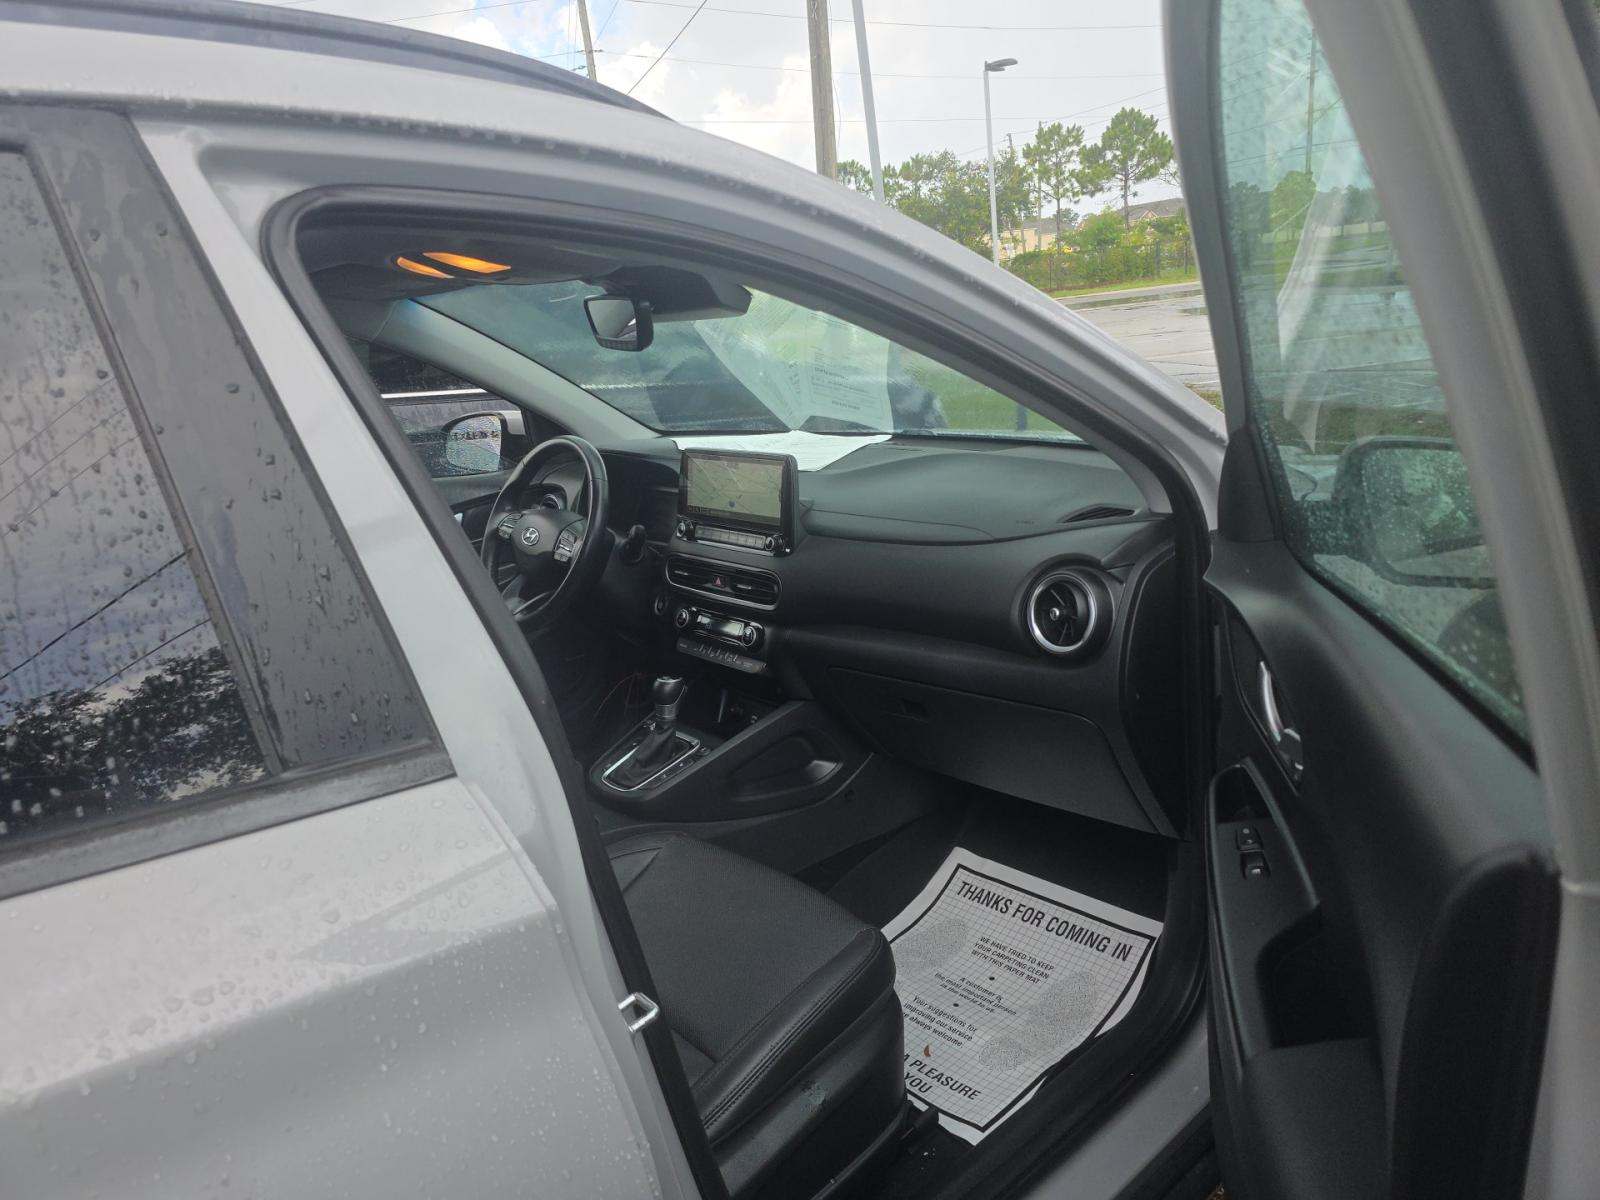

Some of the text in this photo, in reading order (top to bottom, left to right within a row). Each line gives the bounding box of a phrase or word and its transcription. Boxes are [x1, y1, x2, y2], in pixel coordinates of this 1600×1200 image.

[957, 881, 1133, 961] THANKS FOR COMING IN
[971, 949, 1041, 984] WITH THIS PAPER MAT
[974, 942, 1050, 979] YOUR CARPETING CLEAN
[990, 941, 1007, 952] HAVE
[1008, 948, 1027, 960] TRIED
[1028, 956, 1037, 964] TO
[1037, 961, 1054, 971] KEEP
[962, 987, 994, 1004] important
[966, 980, 996, 998] customer
[904, 1003, 973, 1041] improving our service
[909, 1016, 932, 1031] always
[913, 995, 977, 1032] Your suggestions for
[904, 1072, 933, 1093] YOU
[909, 1060, 981, 1100] PLEASURE
